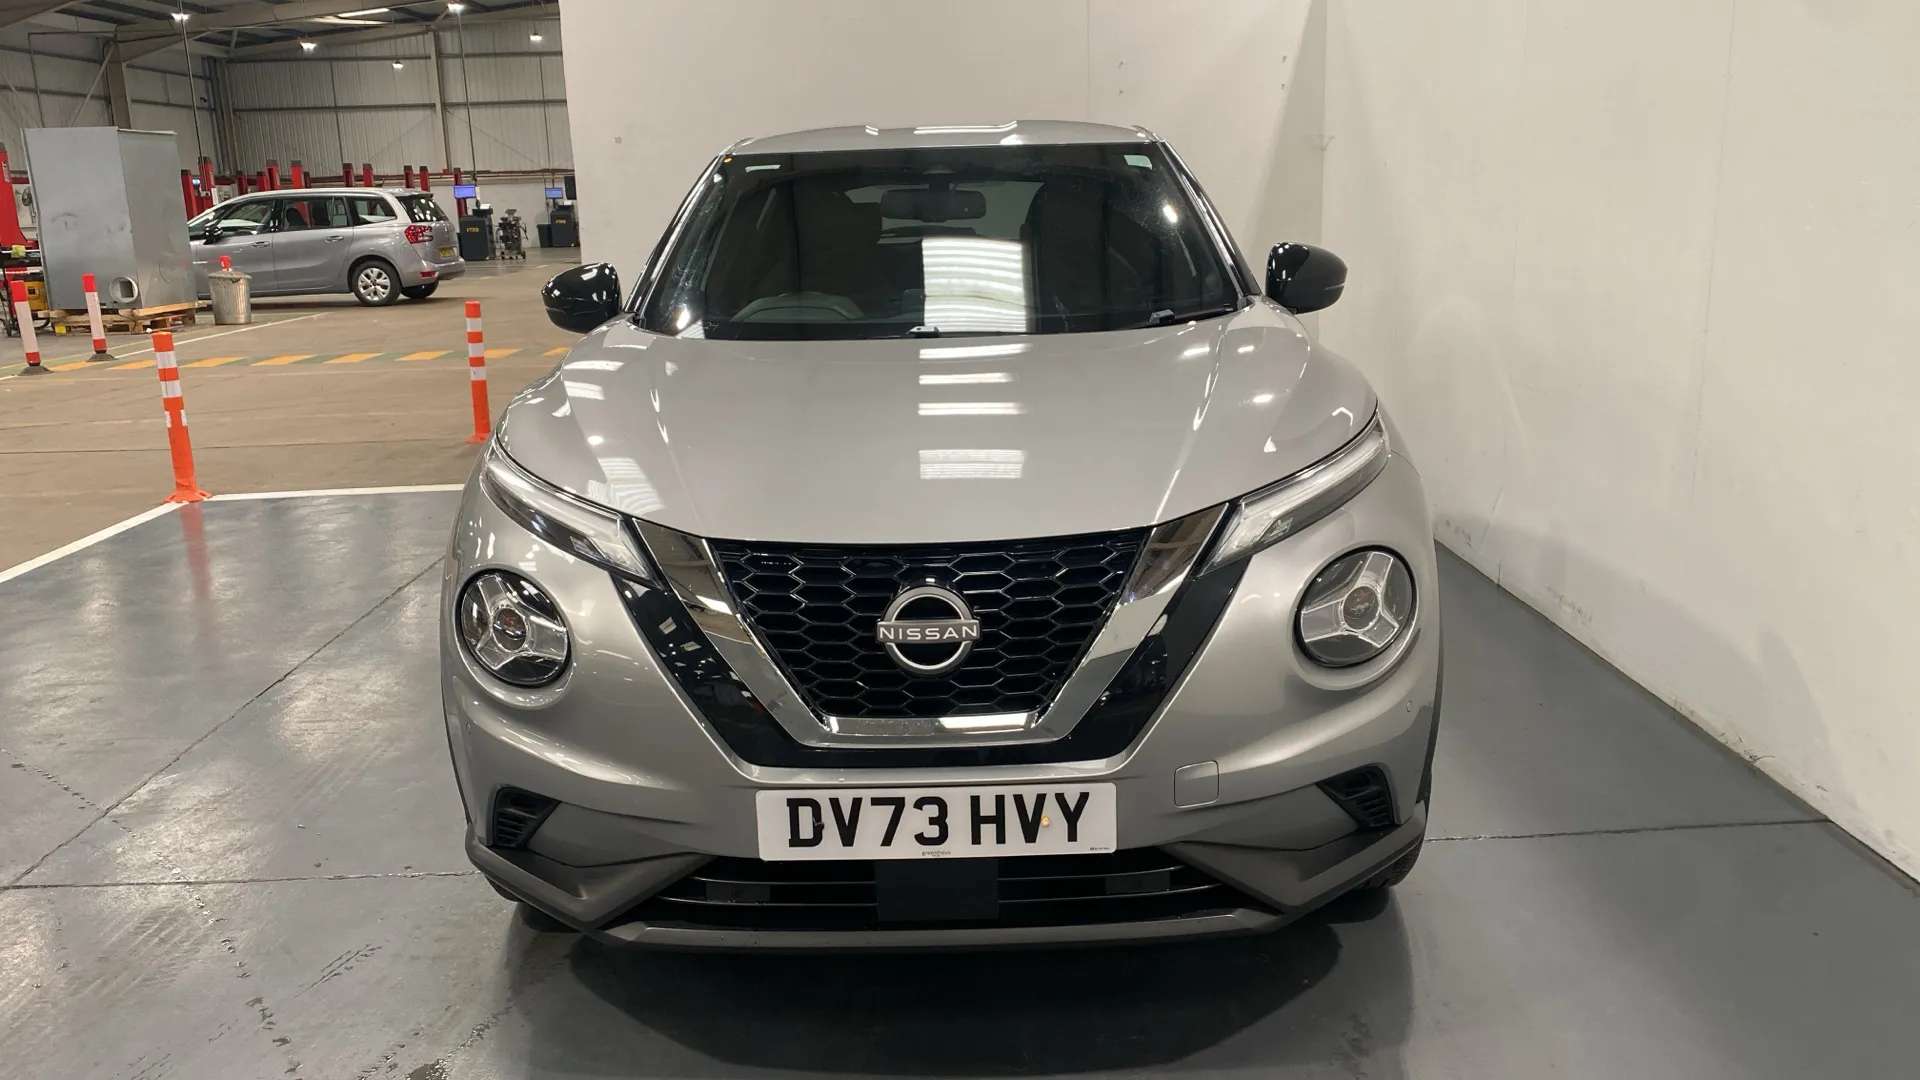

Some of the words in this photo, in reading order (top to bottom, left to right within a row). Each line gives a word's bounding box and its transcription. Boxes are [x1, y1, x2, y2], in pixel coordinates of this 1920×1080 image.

[879, 624, 977, 641] NISSAN
[786, 796, 949, 848] DV73
[969, 791, 1090, 846] HVY
